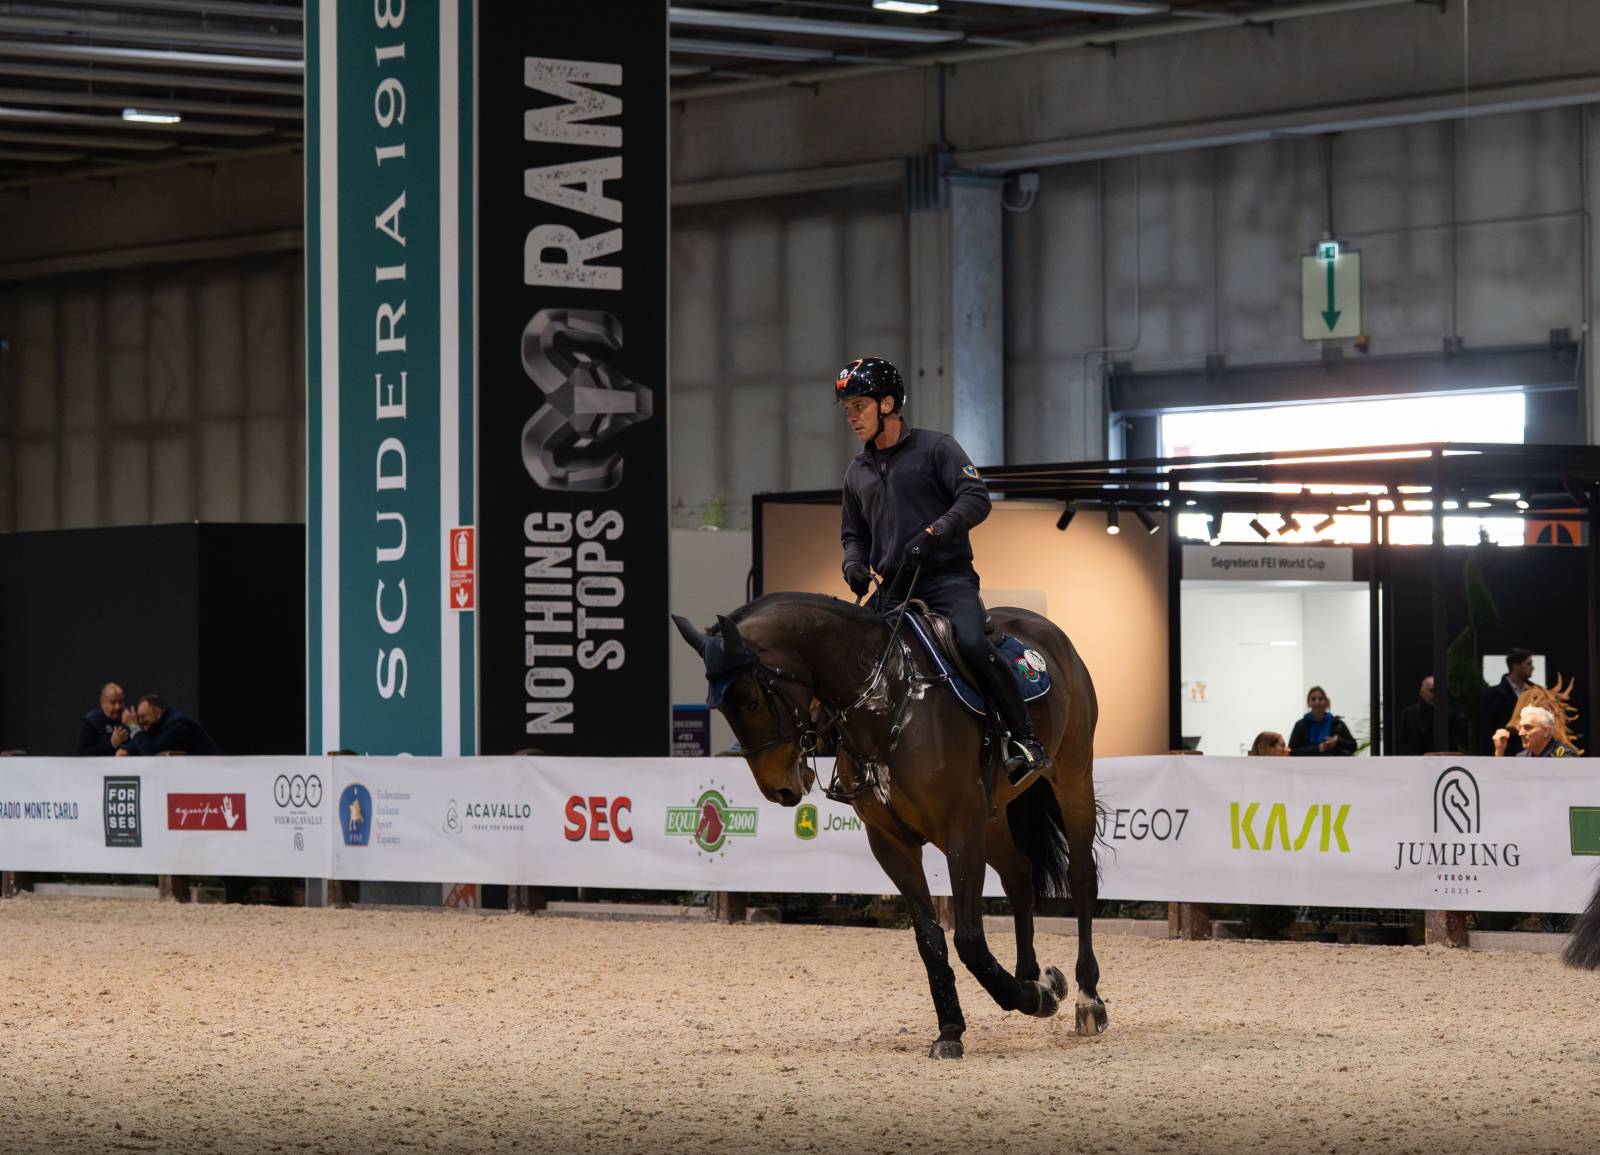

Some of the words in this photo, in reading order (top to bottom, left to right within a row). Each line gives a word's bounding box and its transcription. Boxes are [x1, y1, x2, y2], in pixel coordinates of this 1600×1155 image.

[374, 0, 407, 166] 1918
[523, 56, 623, 291] RAM
[375, 191, 408, 699] SCUDERIA
[1211, 556, 1259, 570] Segreteria
[1261, 557, 1277, 568] FEI
[1278, 558, 1305, 569] World
[1307, 559, 1326, 570] Cup
[575, 509, 626, 671] STOPS
[523, 511, 574, 735] NOTHING
[108, 788, 136, 801] FOR
[25, 802, 52, 820] MONTE
[53, 802, 78, 820] CARLO
[108, 802, 136, 815] HOR
[175, 802, 219, 826] equipe
[465, 803, 531, 818] ACAVALLO
[564, 795, 633, 843] SEC
[108, 816, 137, 830] SES
[667, 812, 696, 832] EQUI
[727, 812, 755, 831] 2000
[1113, 808, 1189, 841] EGO7
[1394, 842, 1521, 870] JUMPING
